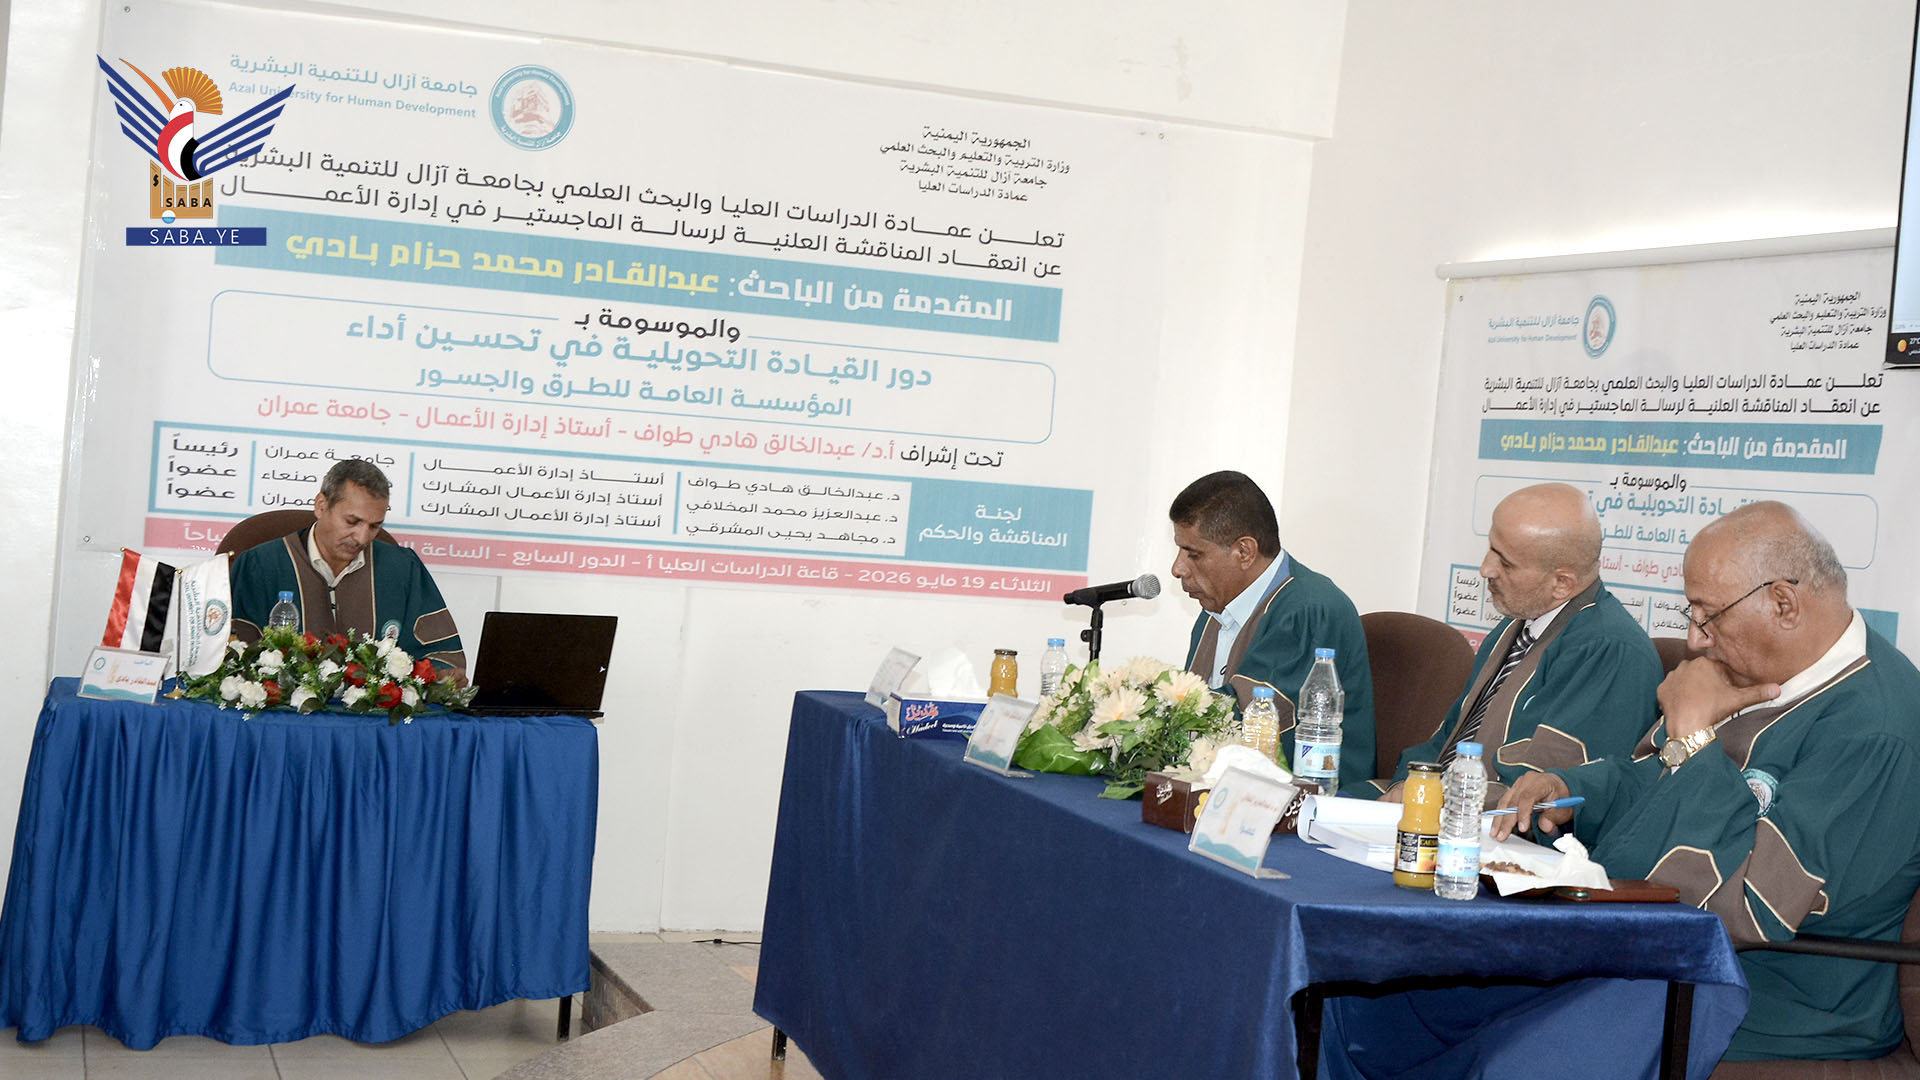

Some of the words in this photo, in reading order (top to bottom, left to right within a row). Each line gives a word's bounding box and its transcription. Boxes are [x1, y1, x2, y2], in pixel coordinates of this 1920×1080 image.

[230, 54, 303, 76] البشرية
[308, 63, 378, 84] للتنمية
[421, 76, 478, 98] جامعة
[228, 81, 255, 94] Azal
[326, 92, 344, 103] for
[347, 94, 392, 109] Human
[396, 100, 476, 118] Development
[923, 126, 967, 143] اليمنية
[972, 132, 1030, 149] الجمهورية
[880, 142, 914, 154] العلمي
[917, 144, 956, 161] والبحث
[320, 154, 398, 177] للتنمية
[900, 160, 943, 176] البشرية
[1005, 155, 1044, 169] التربية
[1047, 160, 1070, 174] وزارة
[947, 165, 988, 179] للتنمية
[1014, 173, 1047, 189] جامعة
[456, 168, 544, 197] بجامعة
[919, 181, 945, 193] العليا
[948, 183, 994, 198] الدراسات
[552, 182, 630, 204] العلمي
[639, 188, 712, 214] والبحث
[997, 189, 1028, 202] عمادة
[388, 191, 438, 218] إدارة
[446, 200, 486, 223] في
[721, 196, 779, 218] العليا
[492, 206, 622, 231] الماجستير
[787, 205, 877, 229] الدراسات
[286, 235, 379, 266] بادي
[389, 241, 461, 270] حزام
[835, 237, 931, 262] المناقشة
[472, 252, 563, 278] محمد
[1034, 262, 1061, 278] عن
[573, 260, 719, 296] عبدالقادر
[844, 284, 883, 310] من
[893, 288, 1012, 321] المقدمة
[346, 313, 407, 341] أداء
[599, 308, 740, 343] والموسومة
[415, 324, 542, 352] تحسين
[550, 334, 603, 368] في
[613, 336, 761, 375] التحويلية
[767, 350, 878, 385] القيادة
[416, 368, 534, 395] والجسور
[542, 373, 630, 398] للطرق
[886, 365, 932, 390] دور
[1602, 377, 1642, 396] العلمي
[1645, 376, 1679, 392] والبحث
[1683, 375, 1713, 393] العليا
[1716, 374, 1766, 392] الدراسات
[639, 381, 723, 406] العامة
[730, 388, 851, 418] المؤسسة
[258, 395, 319, 418] عمران
[326, 399, 391, 420] جامعة
[1742, 398, 1797, 413] المناقشة
[1861, 402, 1880, 417] عن
[416, 406, 495, 429] الأعمال
[502, 413, 547, 439] إدارة
[554, 416, 612, 438] أستاذ
[634, 424, 693, 447] طواف
[700, 431, 758, 455] هادي
[1501, 432, 1536, 453] بادي
[1568, 437, 1607, 451] محمد
[265, 446, 319, 460] عمران
[764, 434, 855, 460] عبدالخالق
[1611, 435, 1679, 457] عبدالقادر
[1744, 437, 1767, 460] من
[1772, 437, 1847, 459] المقدمة
[900, 445, 958, 470] إشراف
[964, 452, 1004, 467] تحت
[261, 470, 317, 483] صنعاء
[537, 466, 574, 481] إدارة
[1622, 472, 1687, 493] والموسومة
[423, 481, 501, 495] المشارك
[688, 477, 741, 490] طواف
[745, 482, 794, 496] هادي
[506, 487, 570, 500] الأعمال
[575, 490, 611, 506] إدارة
[616, 493, 662, 506] أستاذ
[798, 485, 883, 502] عبدالخالق
[421, 502, 499, 517] المشارك
[504, 508, 568, 521] الأعمال
[686, 500, 758, 514] المخلافي
[762, 507, 807, 517] محمد
[975, 504, 1022, 524] لجنة
[1596, 492, 1623, 518] في
[1627, 493, 1694, 517] التحويلية
[573, 511, 609, 527] إدارة
[614, 515, 661, 527] أستاذ
[812, 508, 881, 523] عبدالعزيز
[686, 522, 764, 536] المشرقي
[817, 532, 879, 544] مجاهد
[919, 524, 984, 544] والحكم
[989, 528, 1067, 547] المناقشة
[1636, 526, 1675, 543] العامة
[421, 542, 490, 559] الساعة
[512, 549, 574, 566] السابع
[578, 554, 625, 569] الدور
[659, 557, 706, 574] العليا
[711, 561, 792, 579] الدراسات
[797, 565, 838, 579] قاعة
[858, 570, 911, 584] 2026
[916, 574, 957, 589] مايو
[961, 576, 985, 588] 19
[989, 577, 1051, 592] الثلاثاء
